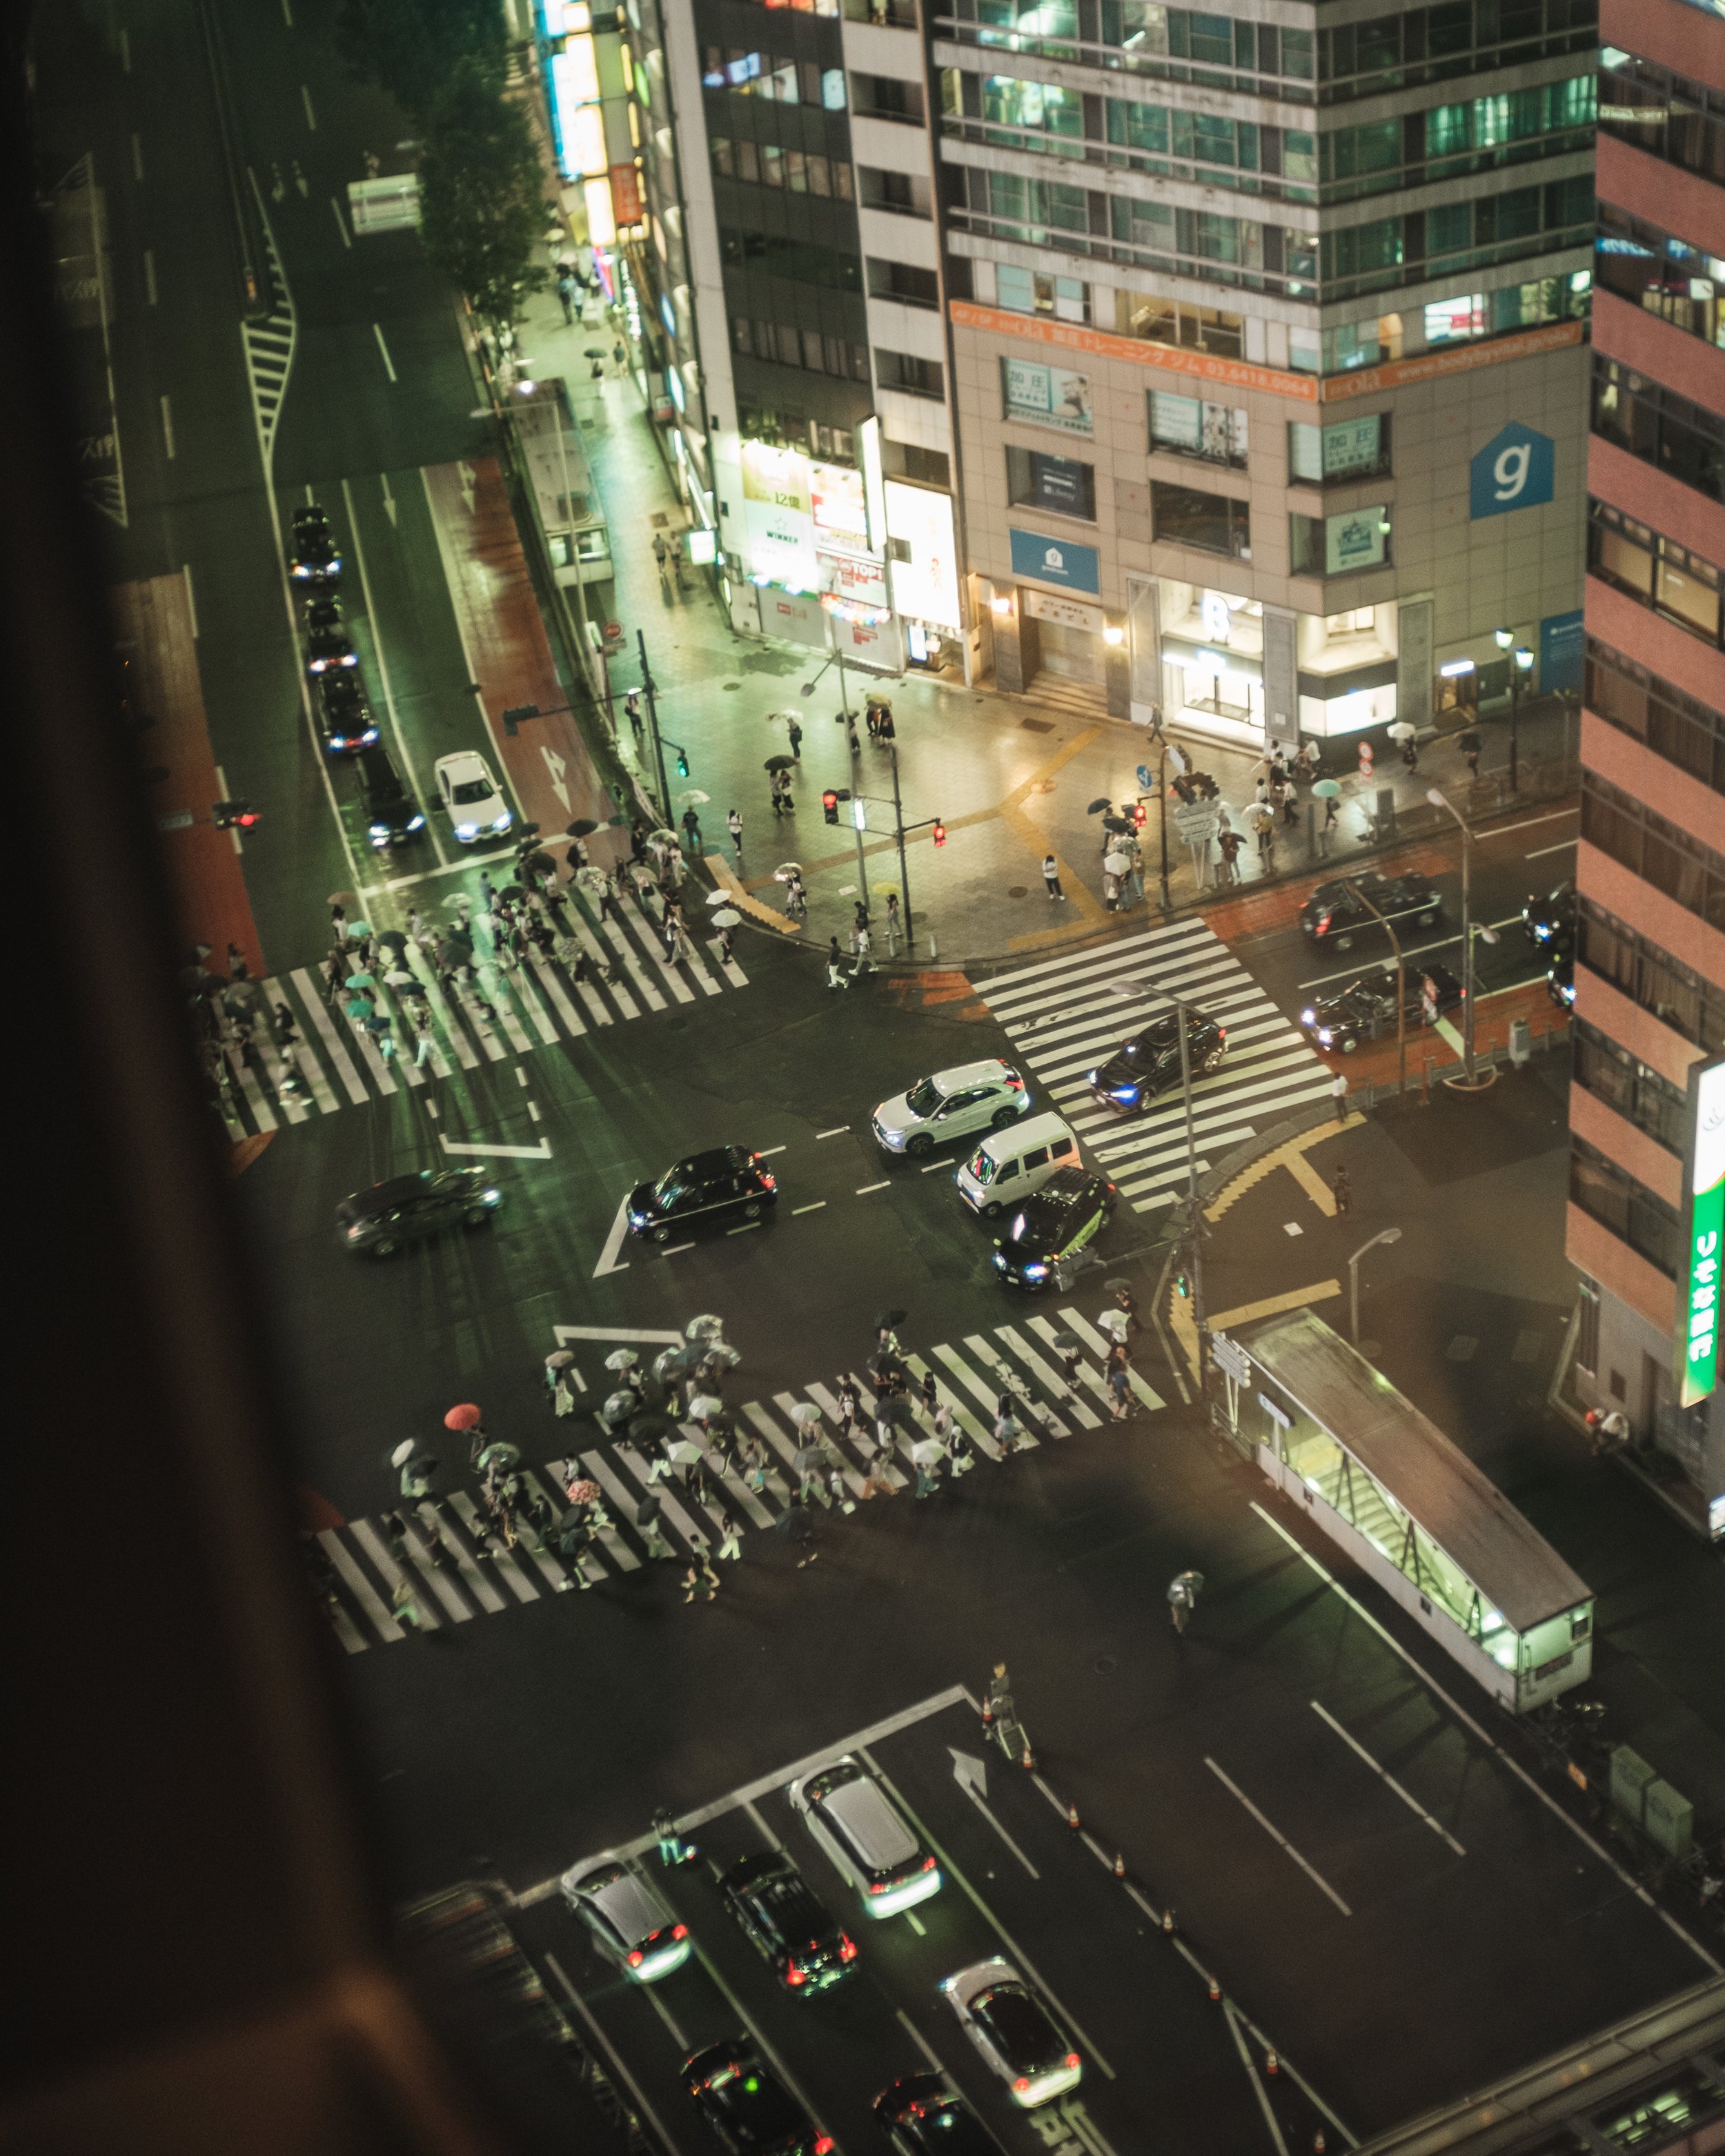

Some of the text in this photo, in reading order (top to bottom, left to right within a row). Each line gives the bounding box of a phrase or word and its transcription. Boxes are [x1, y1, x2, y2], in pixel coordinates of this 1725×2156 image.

[1492, 442, 1532, 502] g
[766, 530, 799, 544] WINNER
[1201, 595, 1231, 638] B
